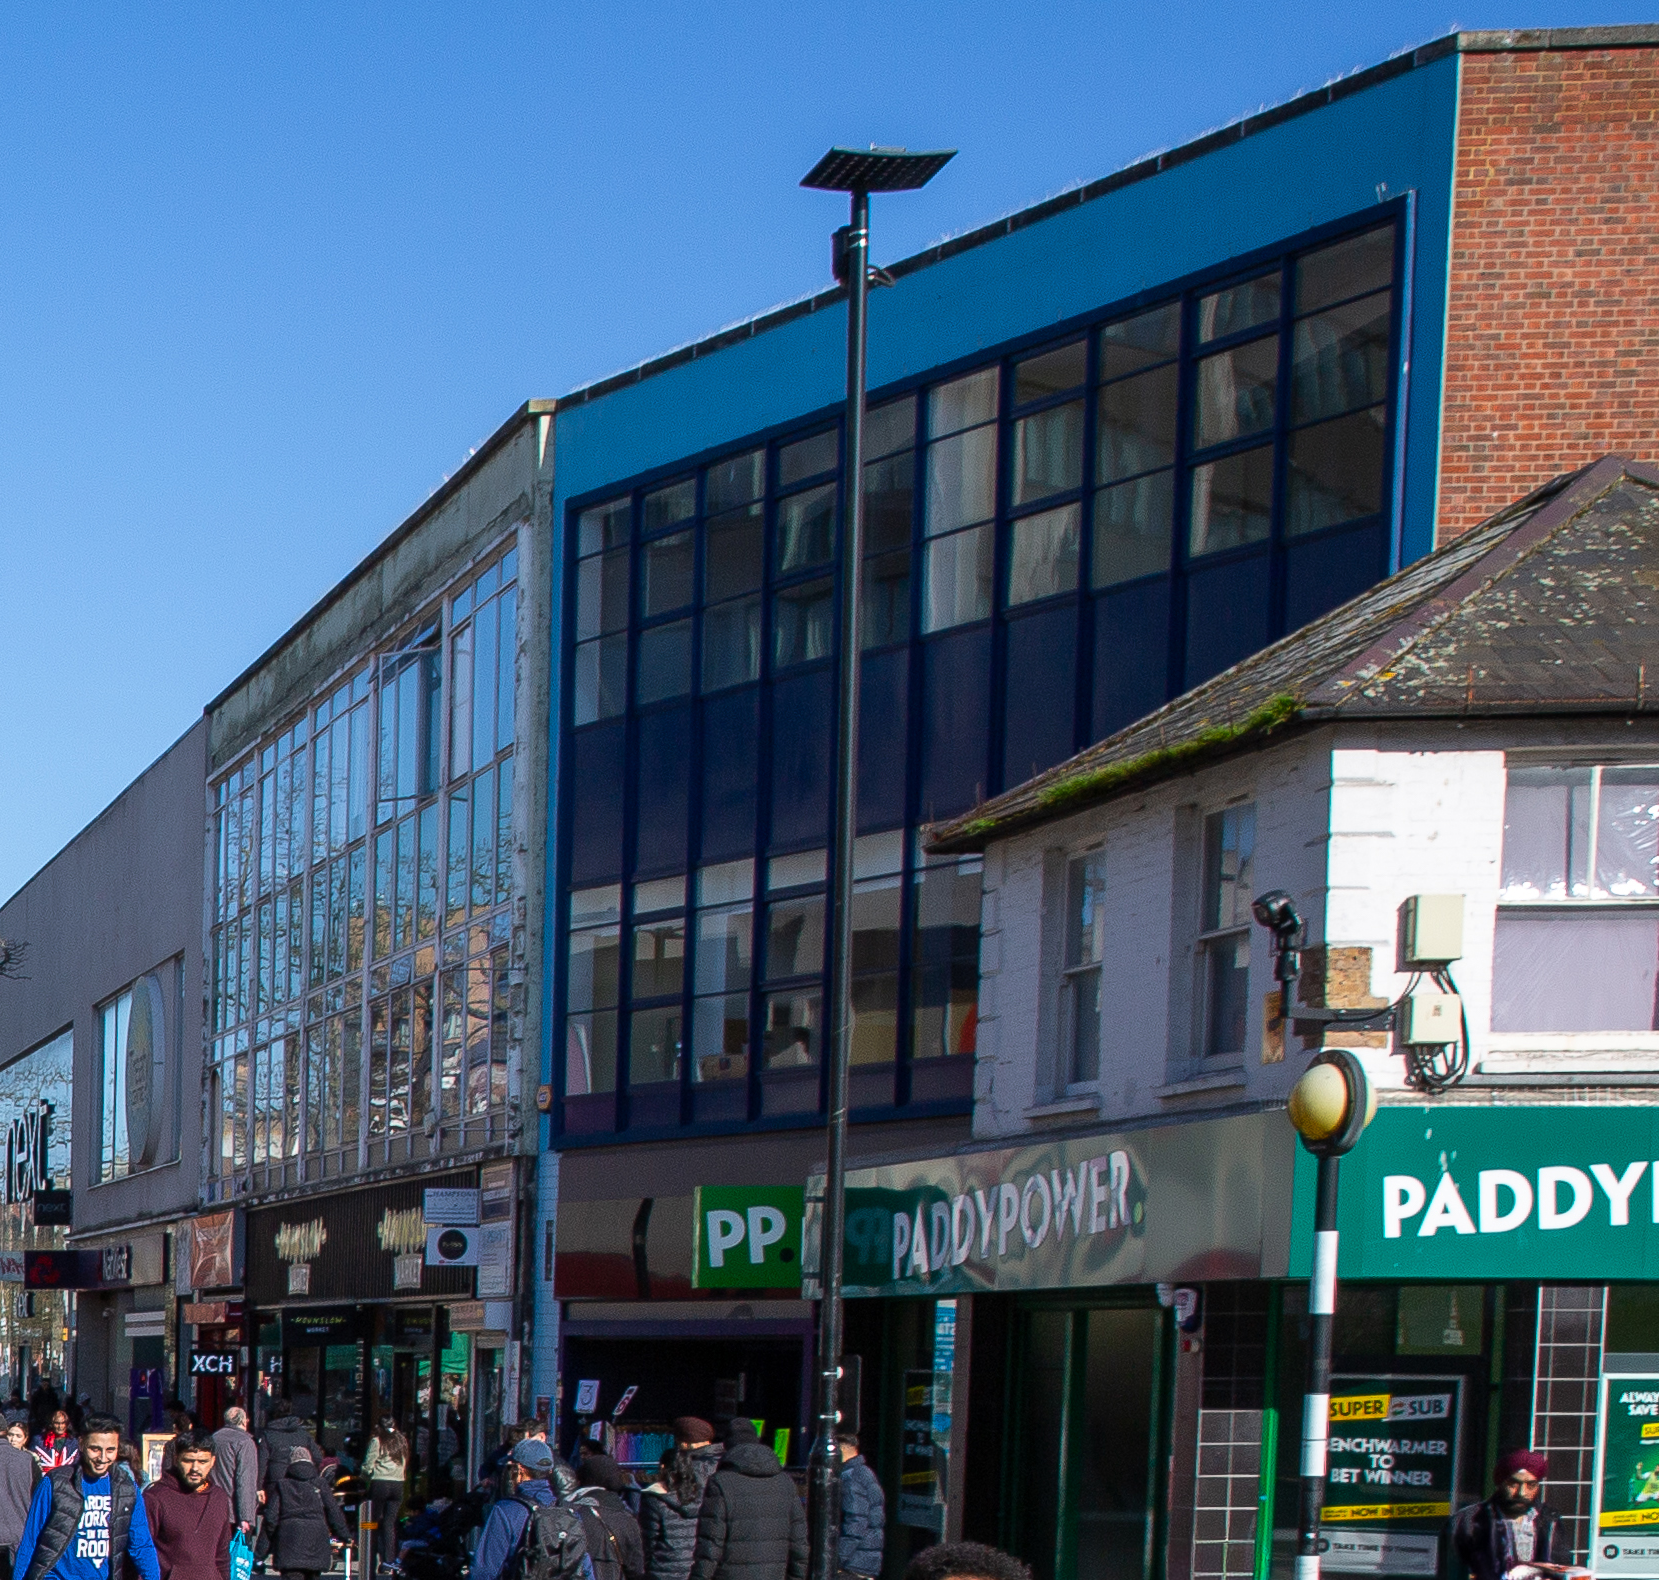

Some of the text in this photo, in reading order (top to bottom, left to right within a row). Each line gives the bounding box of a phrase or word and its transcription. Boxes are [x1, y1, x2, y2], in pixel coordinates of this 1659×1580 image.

[36, 1202, 68, 1213] next
[1383, 1161, 1659, 1239] PADDY
[191, 1354, 233, 1373] XCH
[1329, 1400, 1444, 1417] SUPER SUB
[1627, 1404, 1658, 1416] SAVE
[1328, 1437, 1448, 1456] ENCHWARMER
[1368, 1454, 1395, 1469] TO
[1330, 1468, 1432, 1486] BET WINNER
[83, 1495, 111, 1511] ARDE
